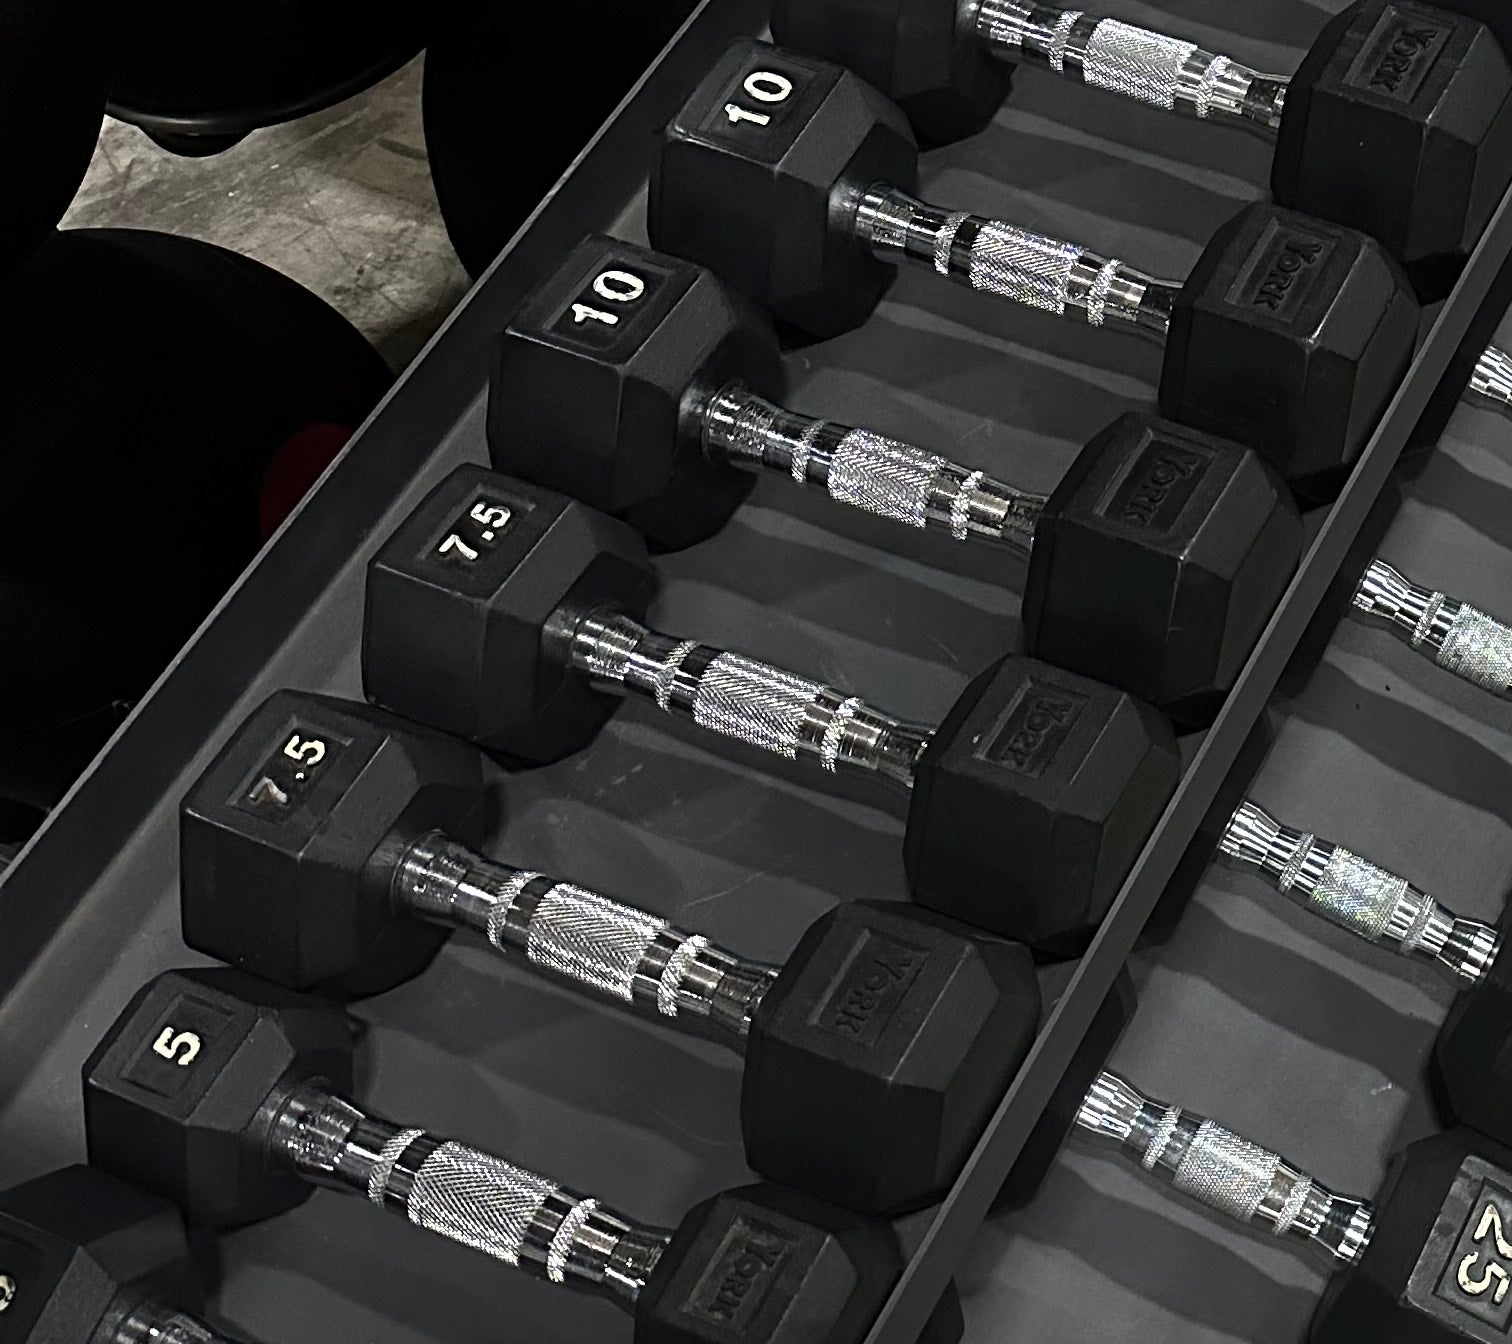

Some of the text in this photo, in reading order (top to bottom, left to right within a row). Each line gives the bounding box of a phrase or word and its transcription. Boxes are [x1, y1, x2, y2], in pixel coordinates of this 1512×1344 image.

[725, 72, 792, 125] 10
[572, 271, 644, 324] 10
[439, 504, 510, 559] 7.5
[249, 735, 325, 803] 7.5
[153, 1027, 200, 1065] 5
